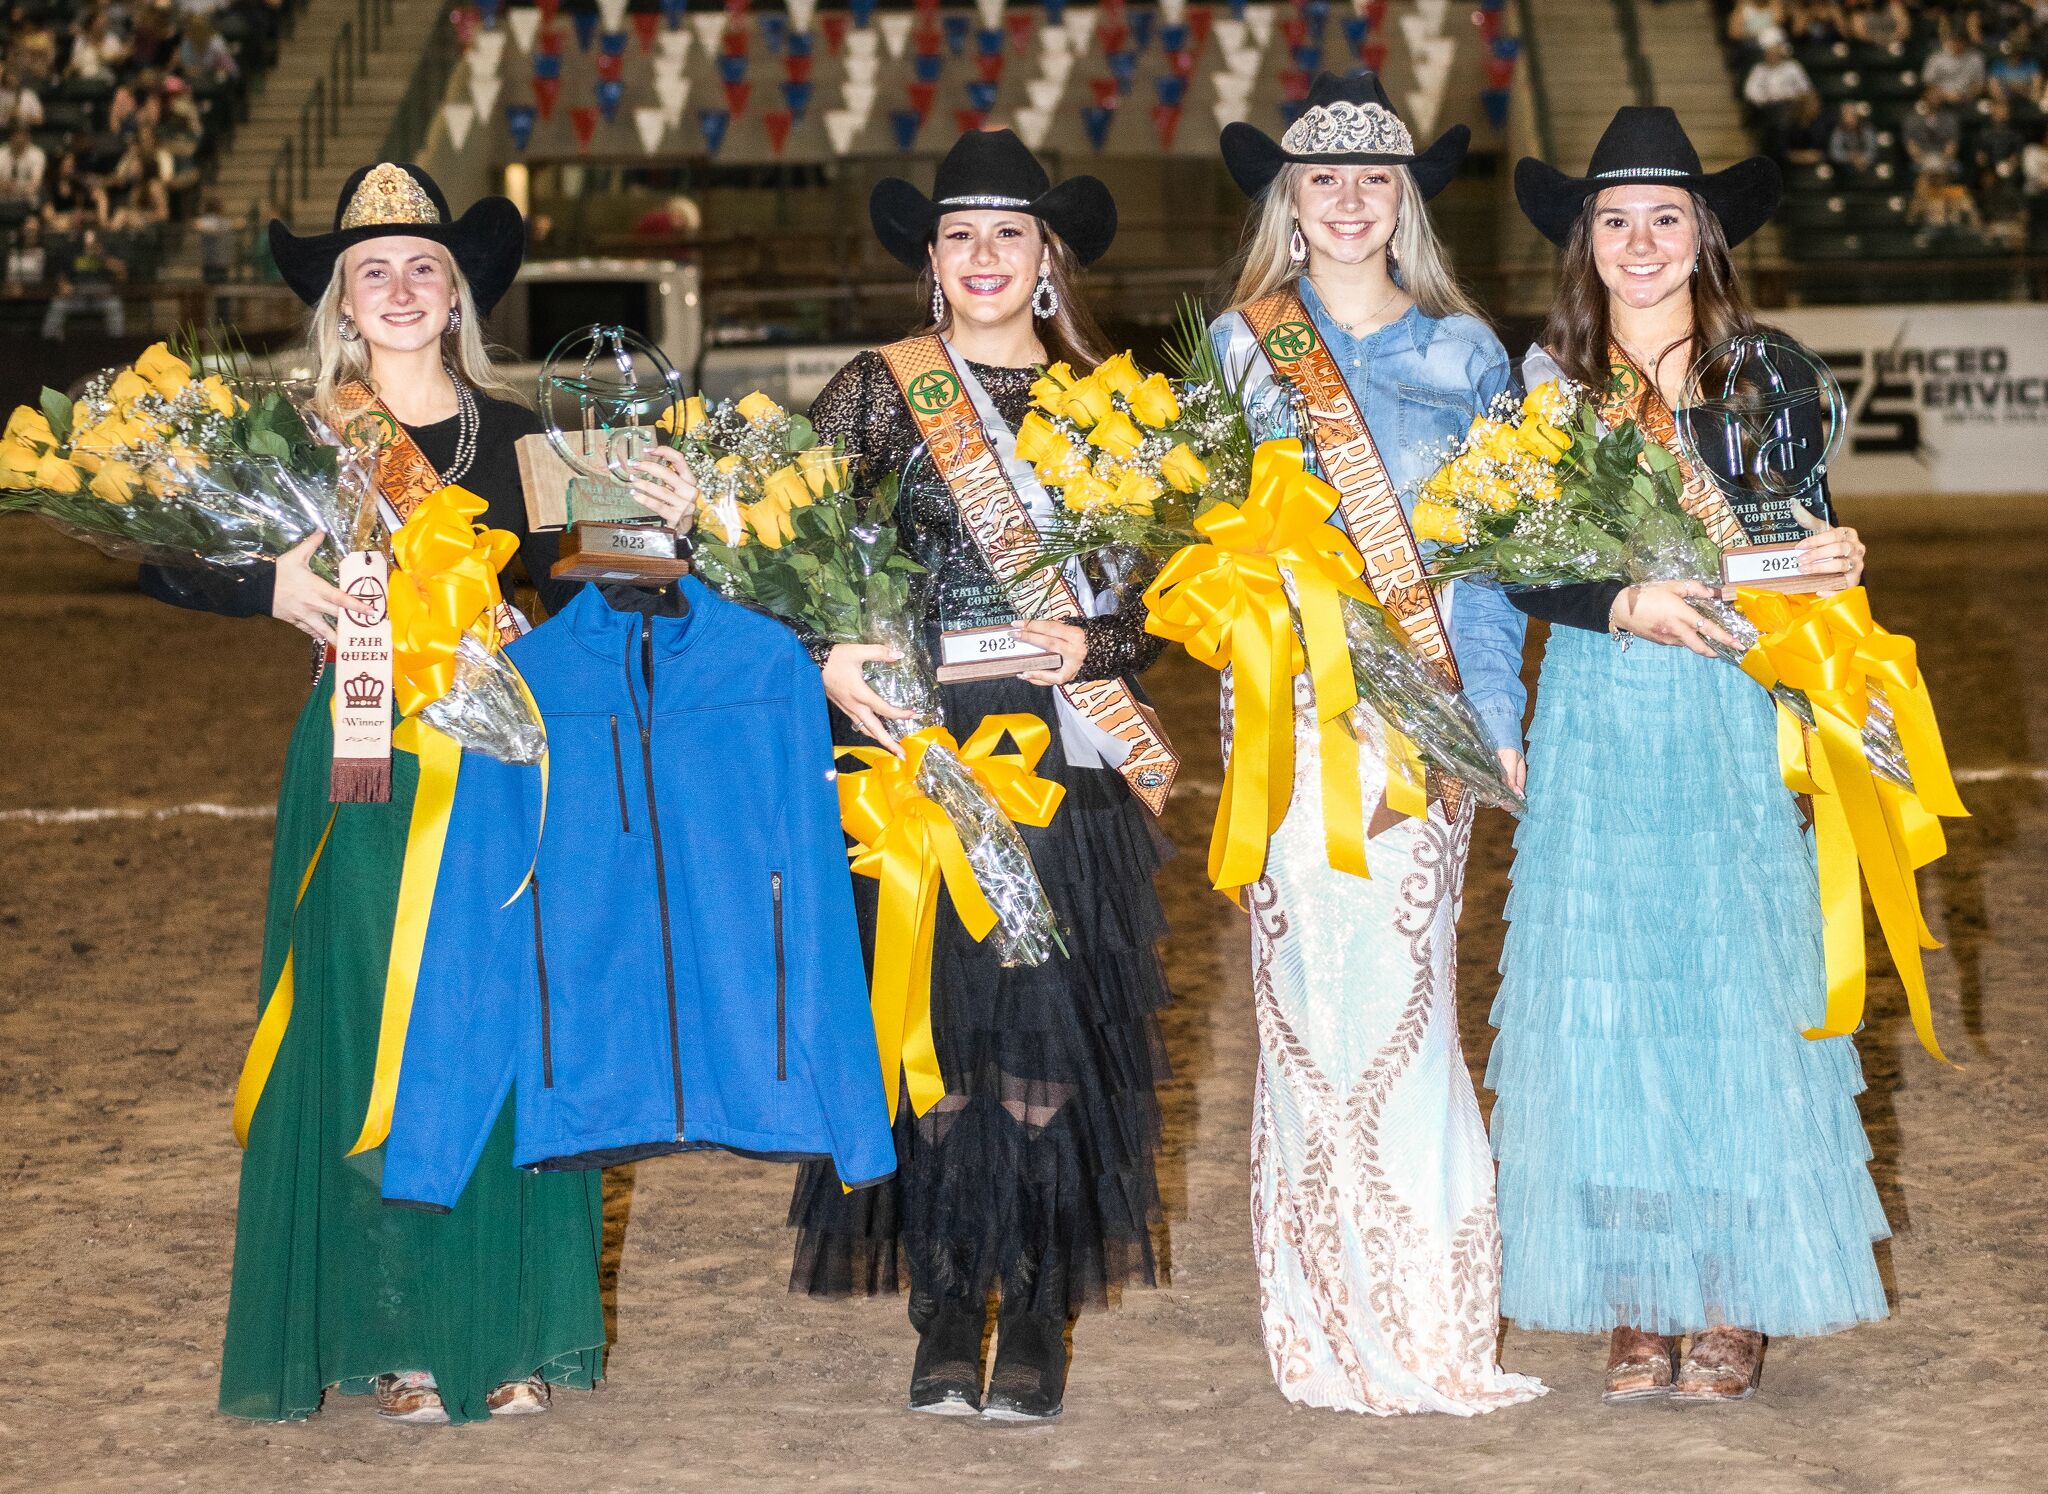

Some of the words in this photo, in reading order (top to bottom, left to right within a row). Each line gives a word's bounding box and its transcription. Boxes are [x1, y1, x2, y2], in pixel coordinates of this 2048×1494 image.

[1307, 349, 1345, 401] MCFA
[948, 453, 1020, 546] MISS
[1729, 503, 1758, 515] FAIR
[1744, 510, 1793, 524] CONTES
[612, 535, 645, 549] 2023
[1322, 432, 1420, 604] RUNNER
[1401, 607, 1447, 662] UP
[1762, 556, 1800, 572] 2023
[951, 586, 980, 598] FAIR
[348, 636, 383, 647] FAIR
[979, 638, 1017, 653] 2023
[341, 651, 388, 661] QUEEN
[342, 716, 385, 728] Winner
